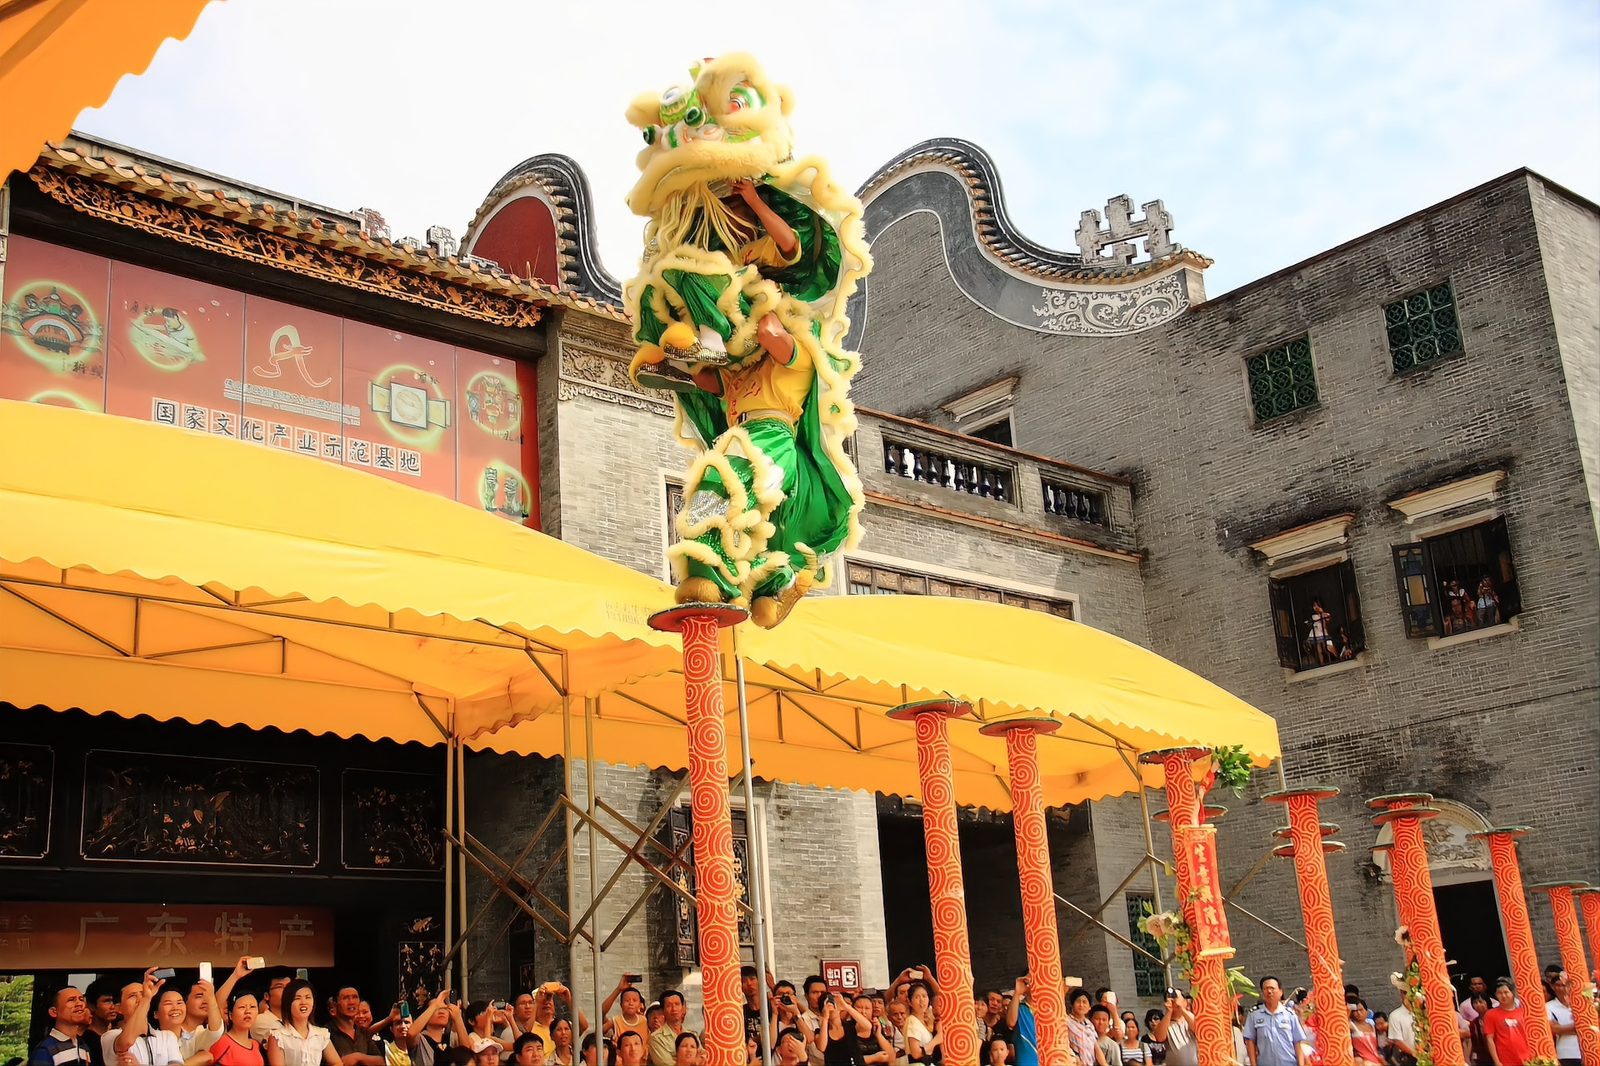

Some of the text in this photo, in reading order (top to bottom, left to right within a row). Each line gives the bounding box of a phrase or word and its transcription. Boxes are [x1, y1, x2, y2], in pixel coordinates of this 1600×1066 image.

[156, 401, 420, 473] 国家文化产业示范基地
[74, 911, 315, 956] 广东特产
